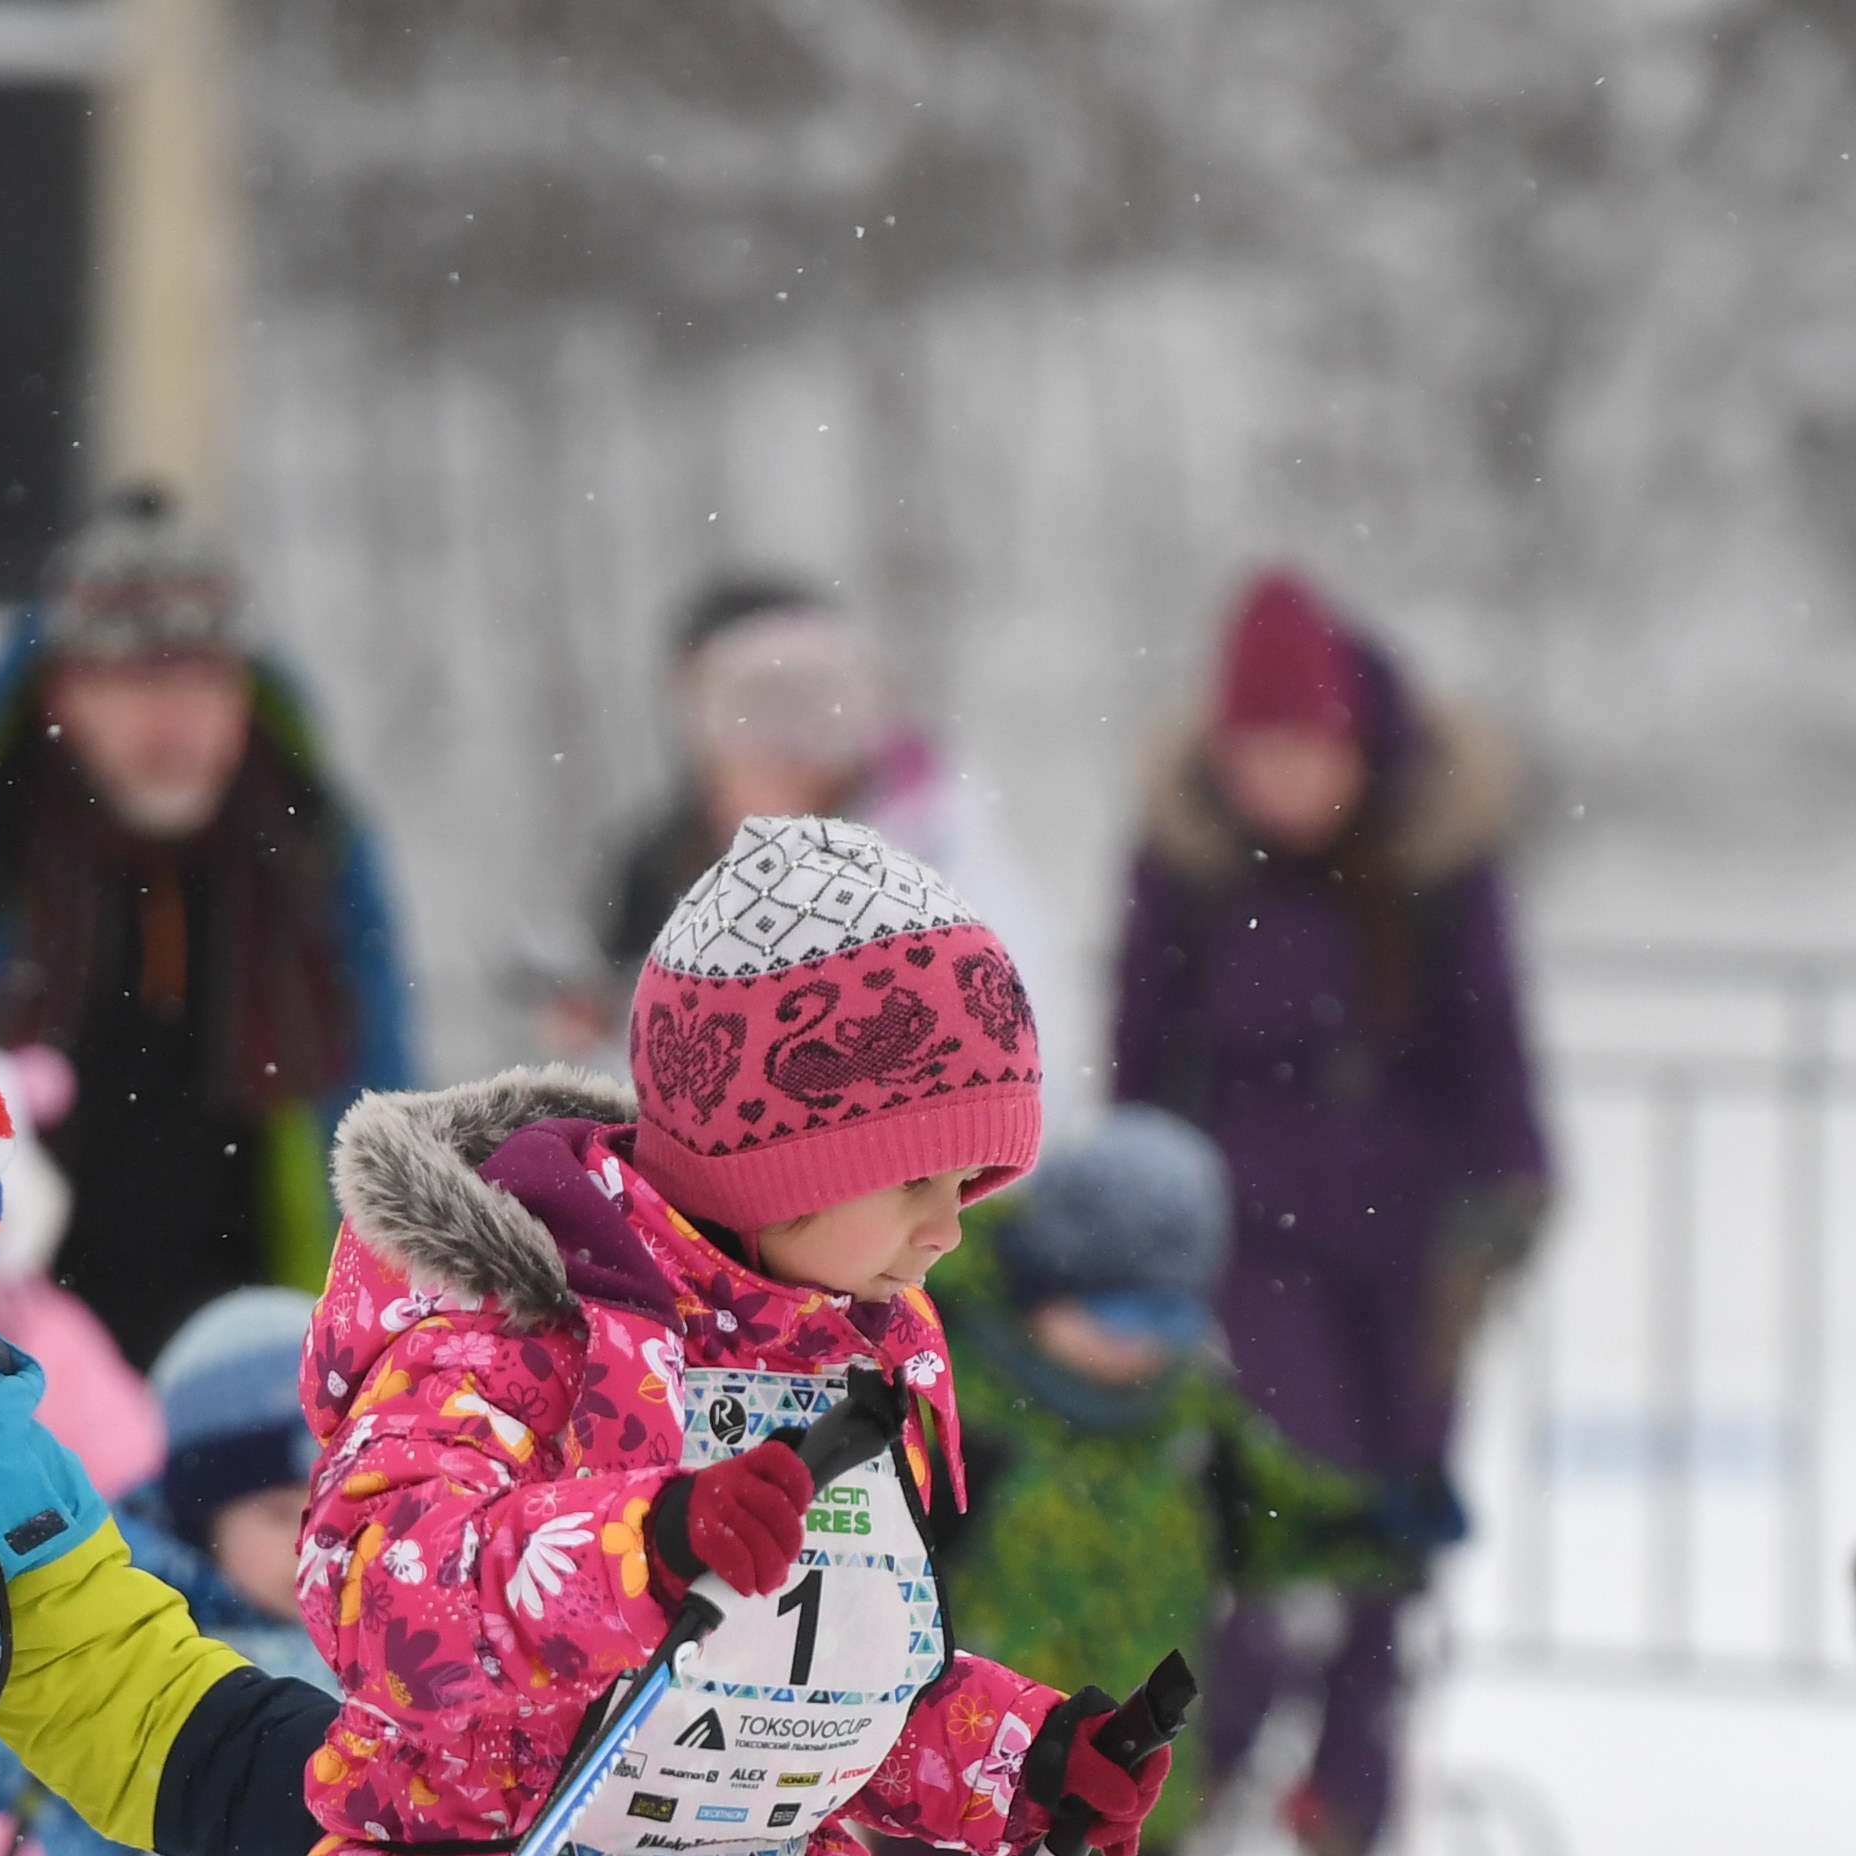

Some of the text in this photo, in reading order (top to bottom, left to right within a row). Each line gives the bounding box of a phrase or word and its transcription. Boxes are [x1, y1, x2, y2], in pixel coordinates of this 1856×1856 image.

[806, 1508, 872, 1536] RES
[777, 1569, 824, 1686] 1
[738, 1714, 873, 1739] TOKSOVOCUP
[729, 1767, 768, 1782] ALEX
